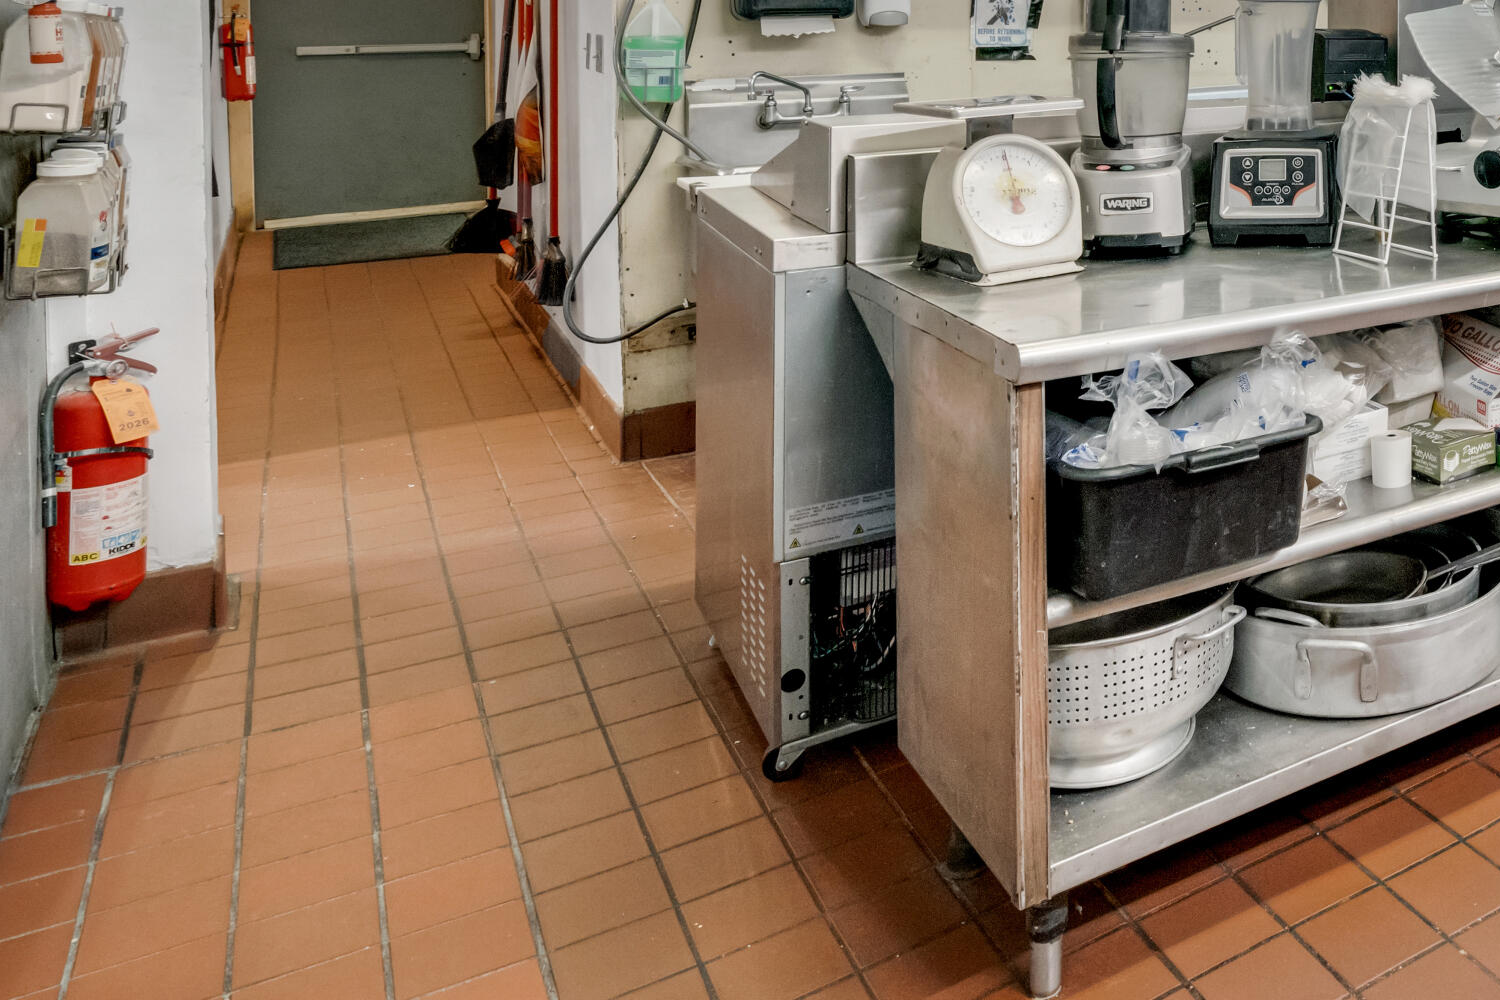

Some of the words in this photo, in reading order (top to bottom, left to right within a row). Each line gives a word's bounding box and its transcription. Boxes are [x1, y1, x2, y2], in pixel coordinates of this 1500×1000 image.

[1106, 198, 1148, 210] WARING
[119, 417, 150, 432] 2026
[108, 541, 136, 555] KIDDE
[72, 552, 98, 563] ABC
